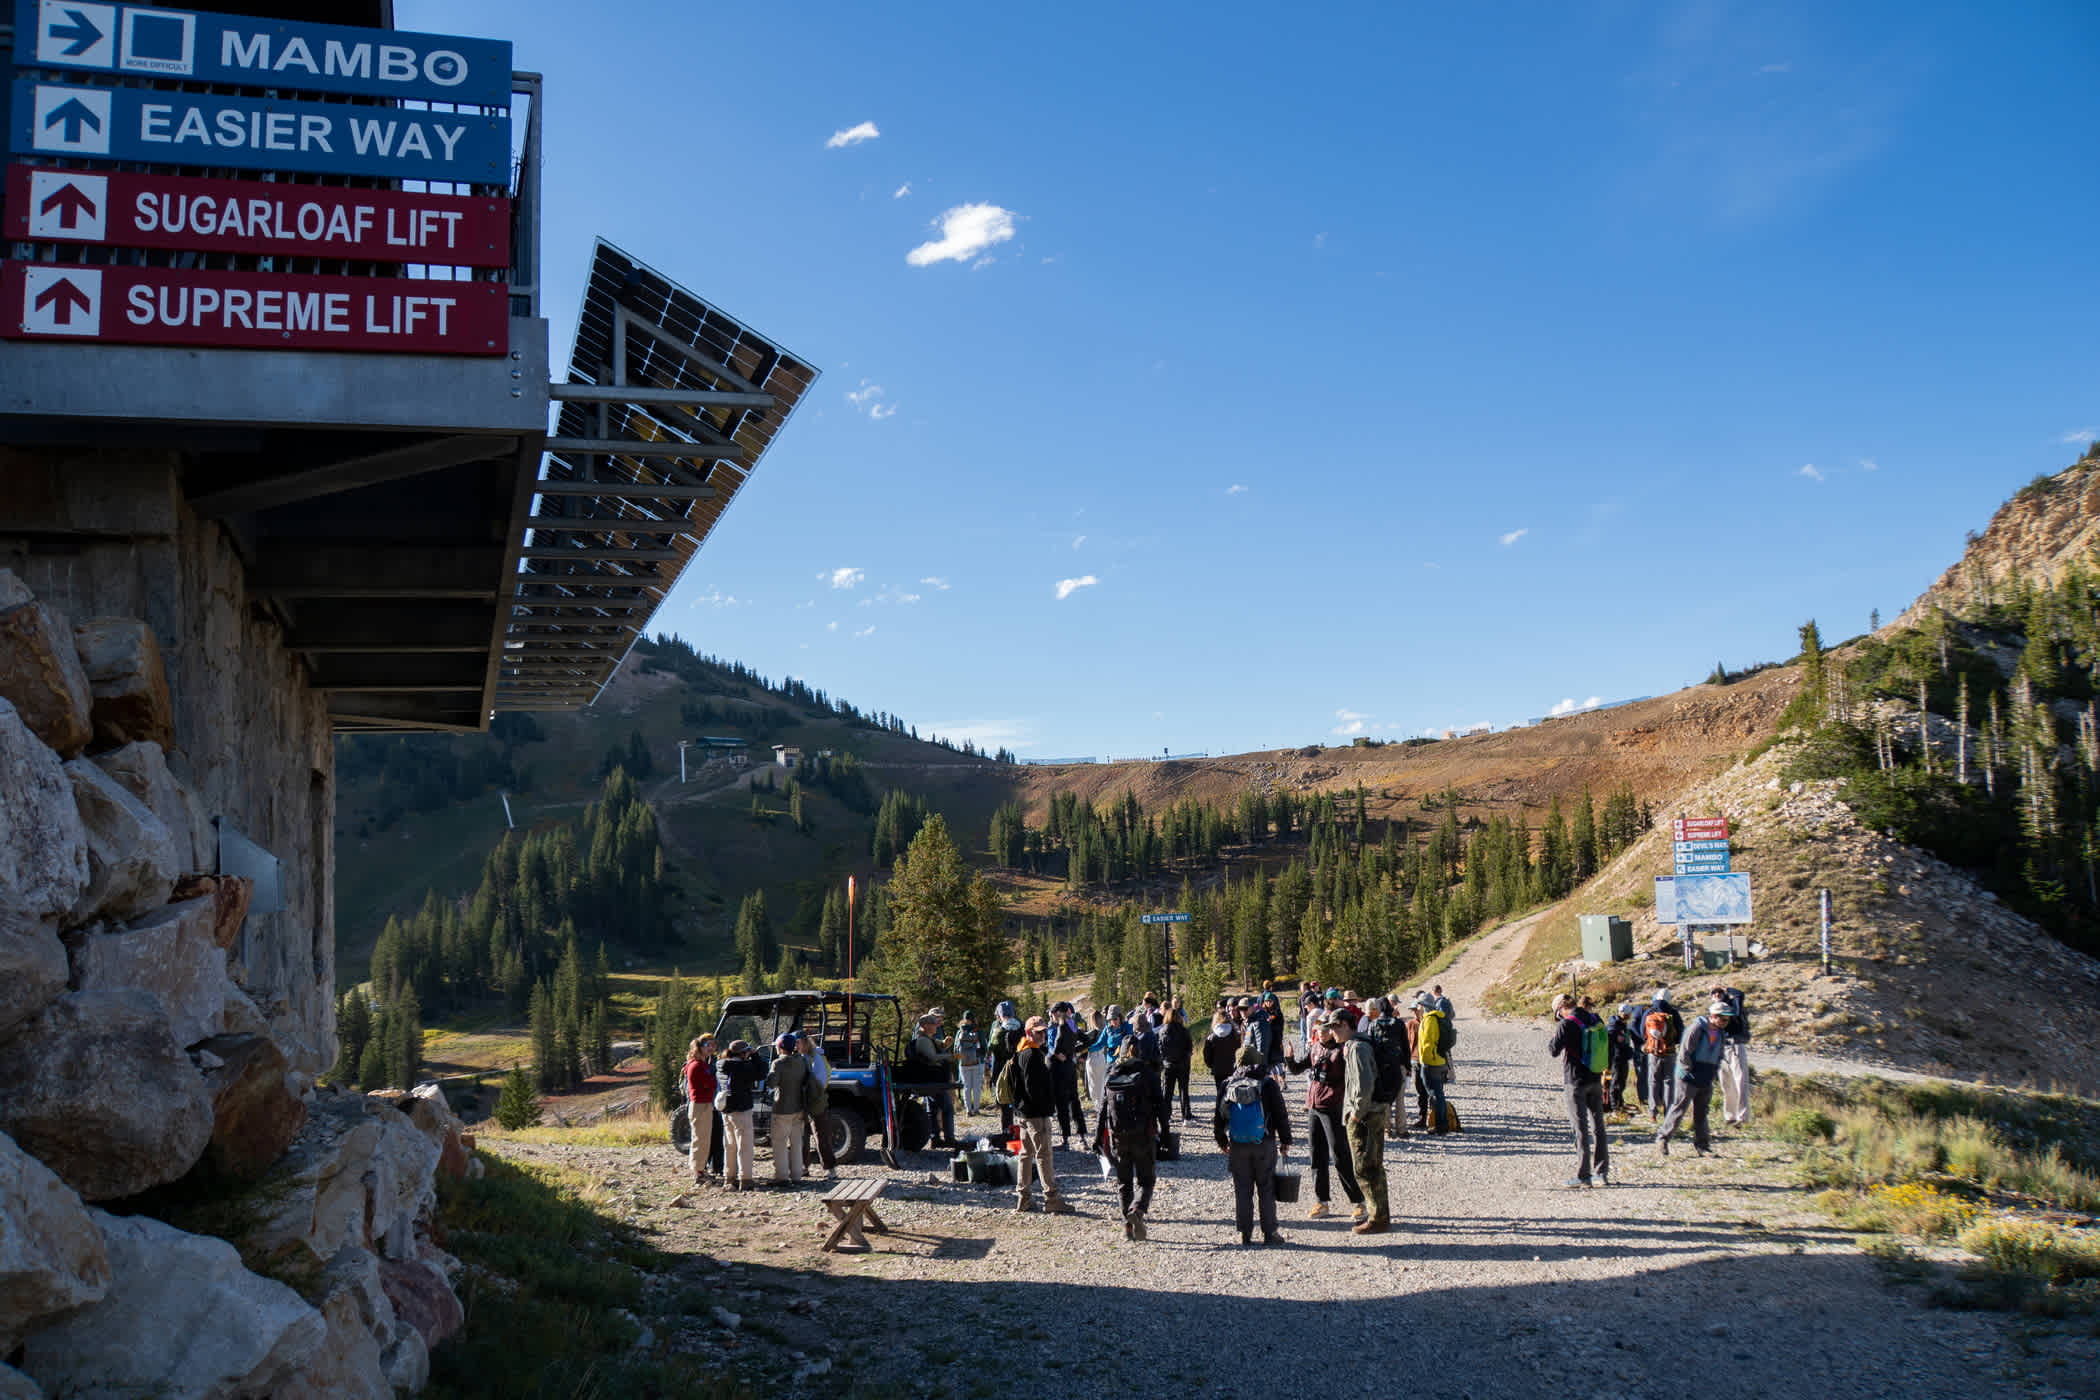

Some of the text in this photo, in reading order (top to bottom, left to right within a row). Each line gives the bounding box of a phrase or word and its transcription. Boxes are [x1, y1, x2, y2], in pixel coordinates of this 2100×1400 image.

[221, 30, 468, 86] MAMBO
[141, 104, 466, 161] EASIER WAY
[134, 191, 463, 249] SUGARLOAF LIFT
[126, 284, 456, 337] SUPREME LIFT
